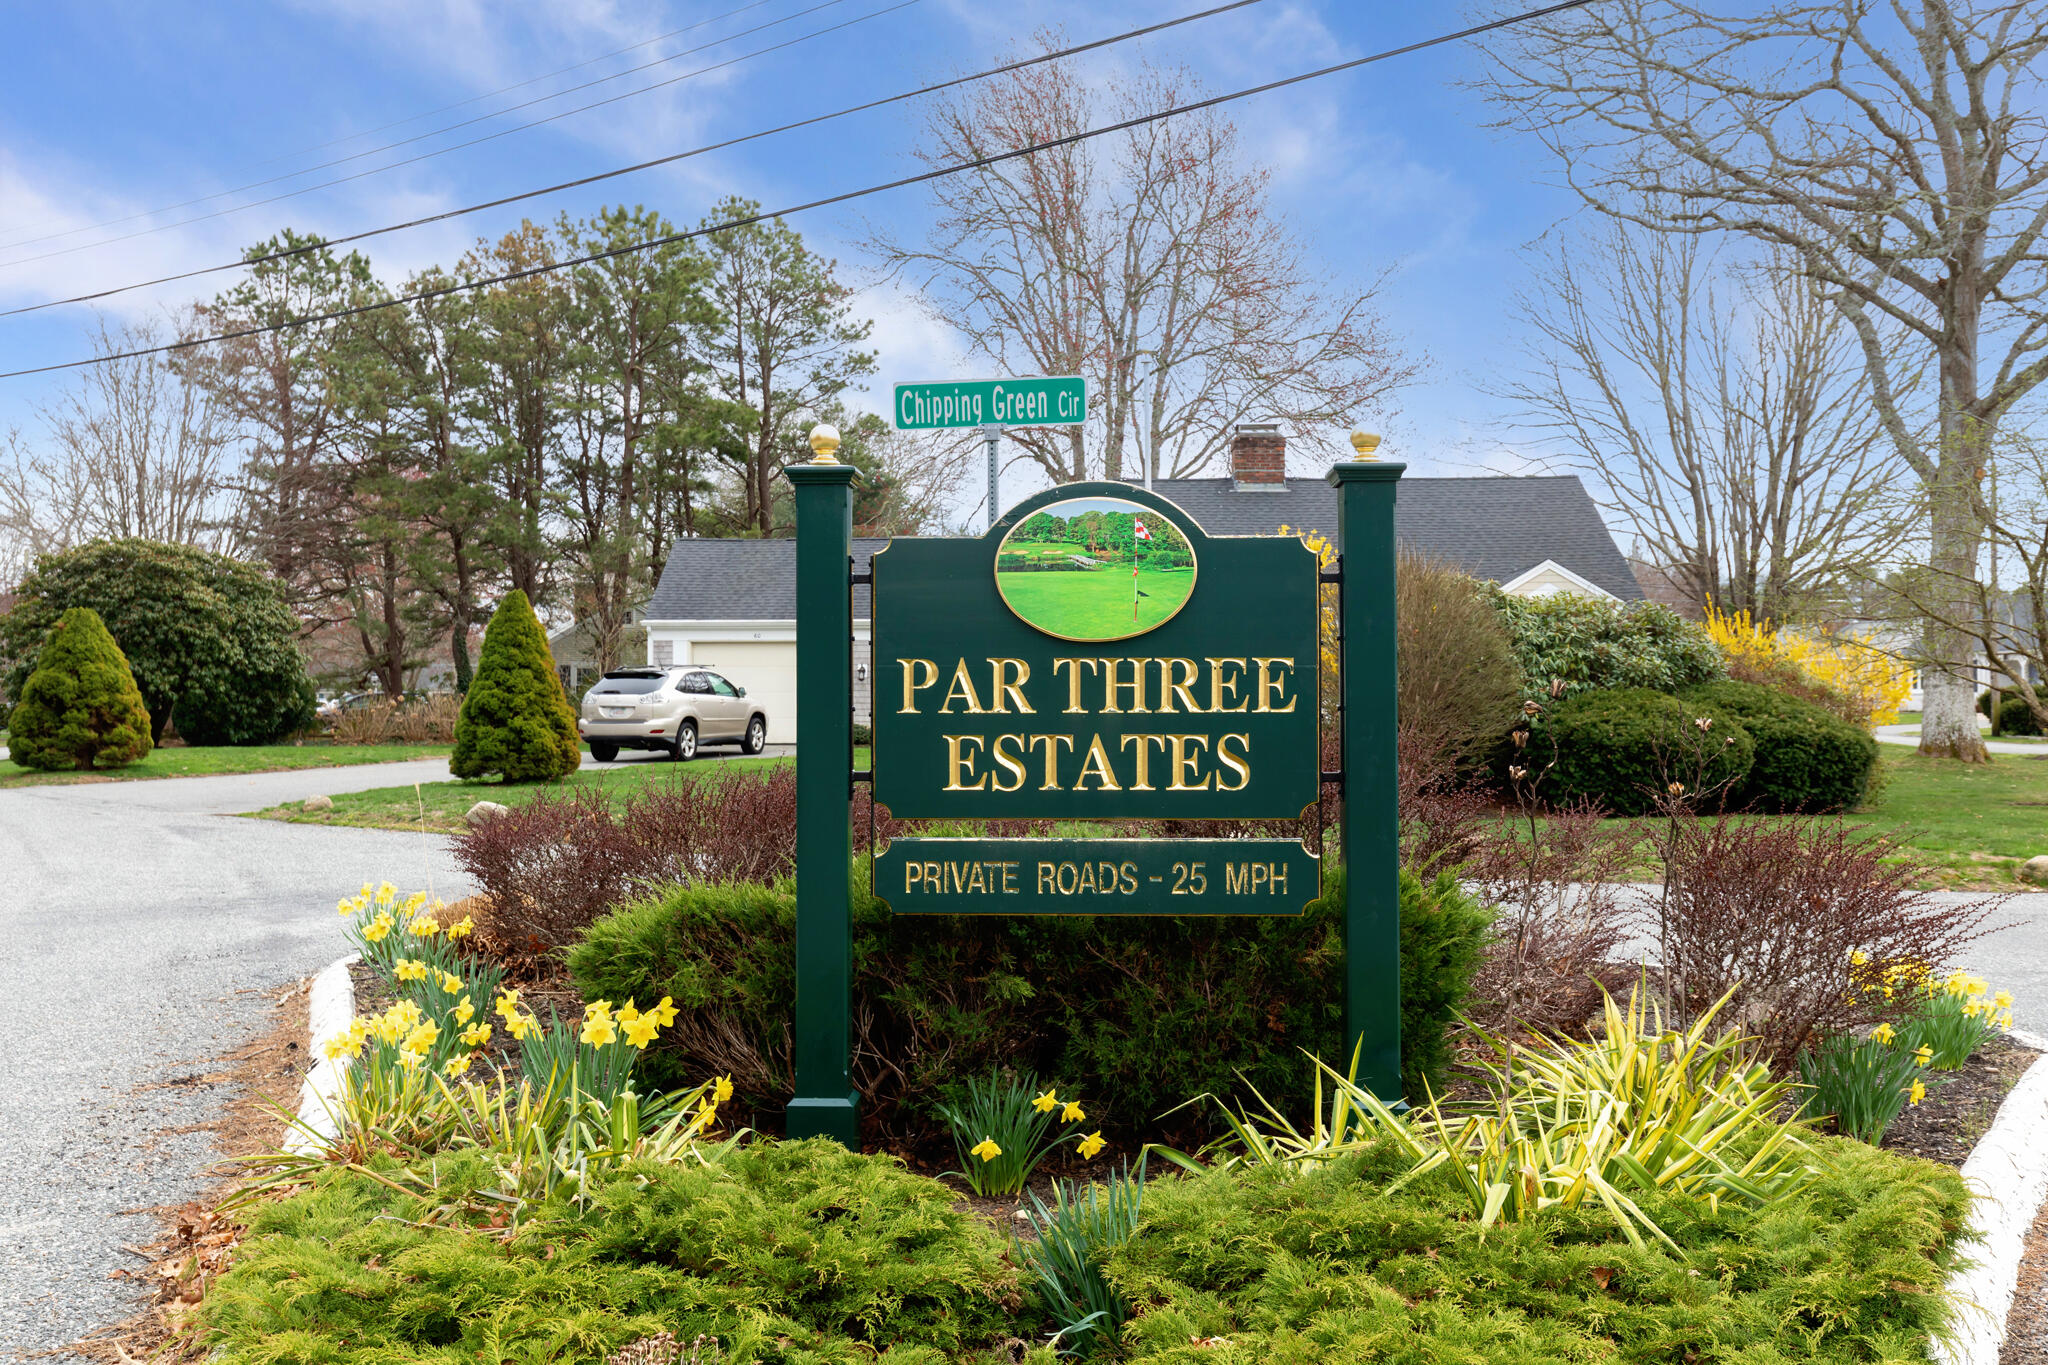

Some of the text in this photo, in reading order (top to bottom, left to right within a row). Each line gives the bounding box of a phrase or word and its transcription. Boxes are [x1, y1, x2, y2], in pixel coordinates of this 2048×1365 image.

[901, 385, 1080, 425] Chipping Green Cir
[896, 657, 1298, 714] PAR THREE
[942, 733, 1251, 792] ESTATES
[904, 861, 1020, 894] PRIVATE
[1037, 861, 1138, 895] ROADS
[1171, 861, 1207, 895] 25
[1225, 862, 1289, 895] MPH
